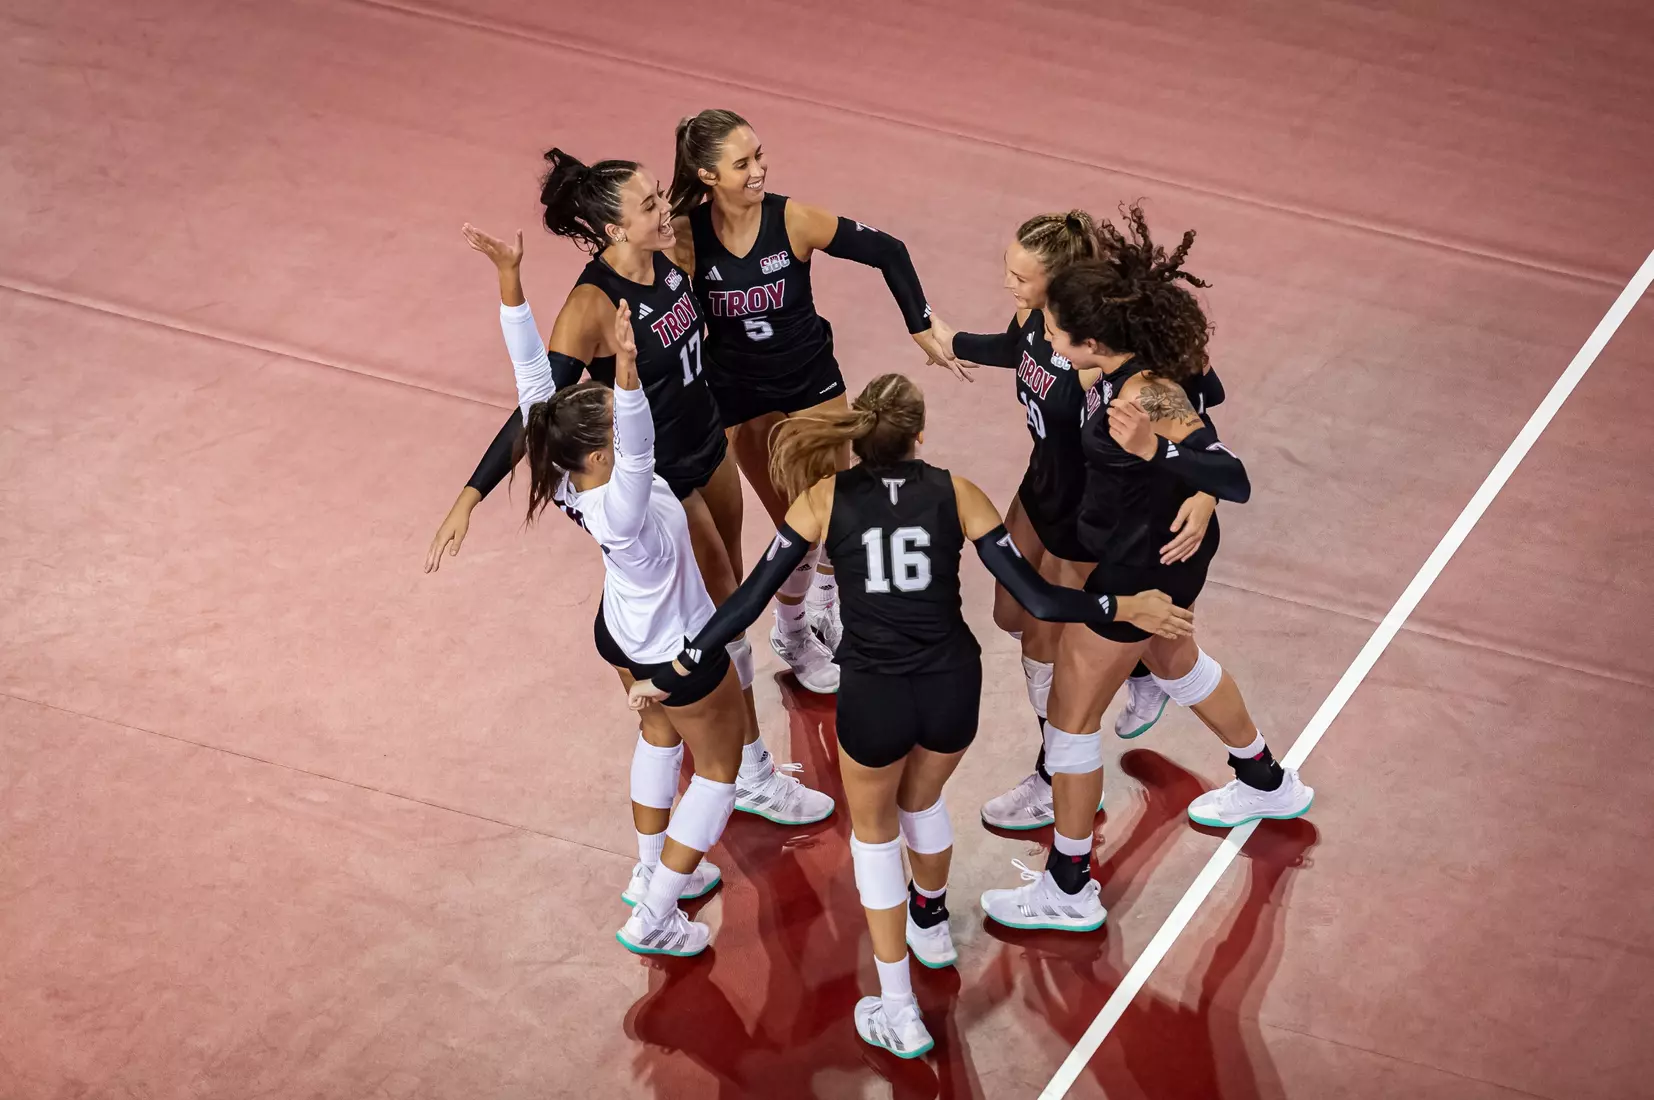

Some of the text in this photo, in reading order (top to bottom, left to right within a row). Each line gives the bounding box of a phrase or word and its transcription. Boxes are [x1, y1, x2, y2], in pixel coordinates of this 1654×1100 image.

[759, 250, 791, 275] SBC
[650, 291, 699, 349] TROY
[708, 278, 786, 317] TROY
[741, 316, 775, 342] 5
[679, 329, 704, 388] 17
[1017, 349, 1057, 401] TROY
[1019, 390, 1047, 440] 10
[880, 477, 907, 506] T
[861, 525, 933, 594] 16
